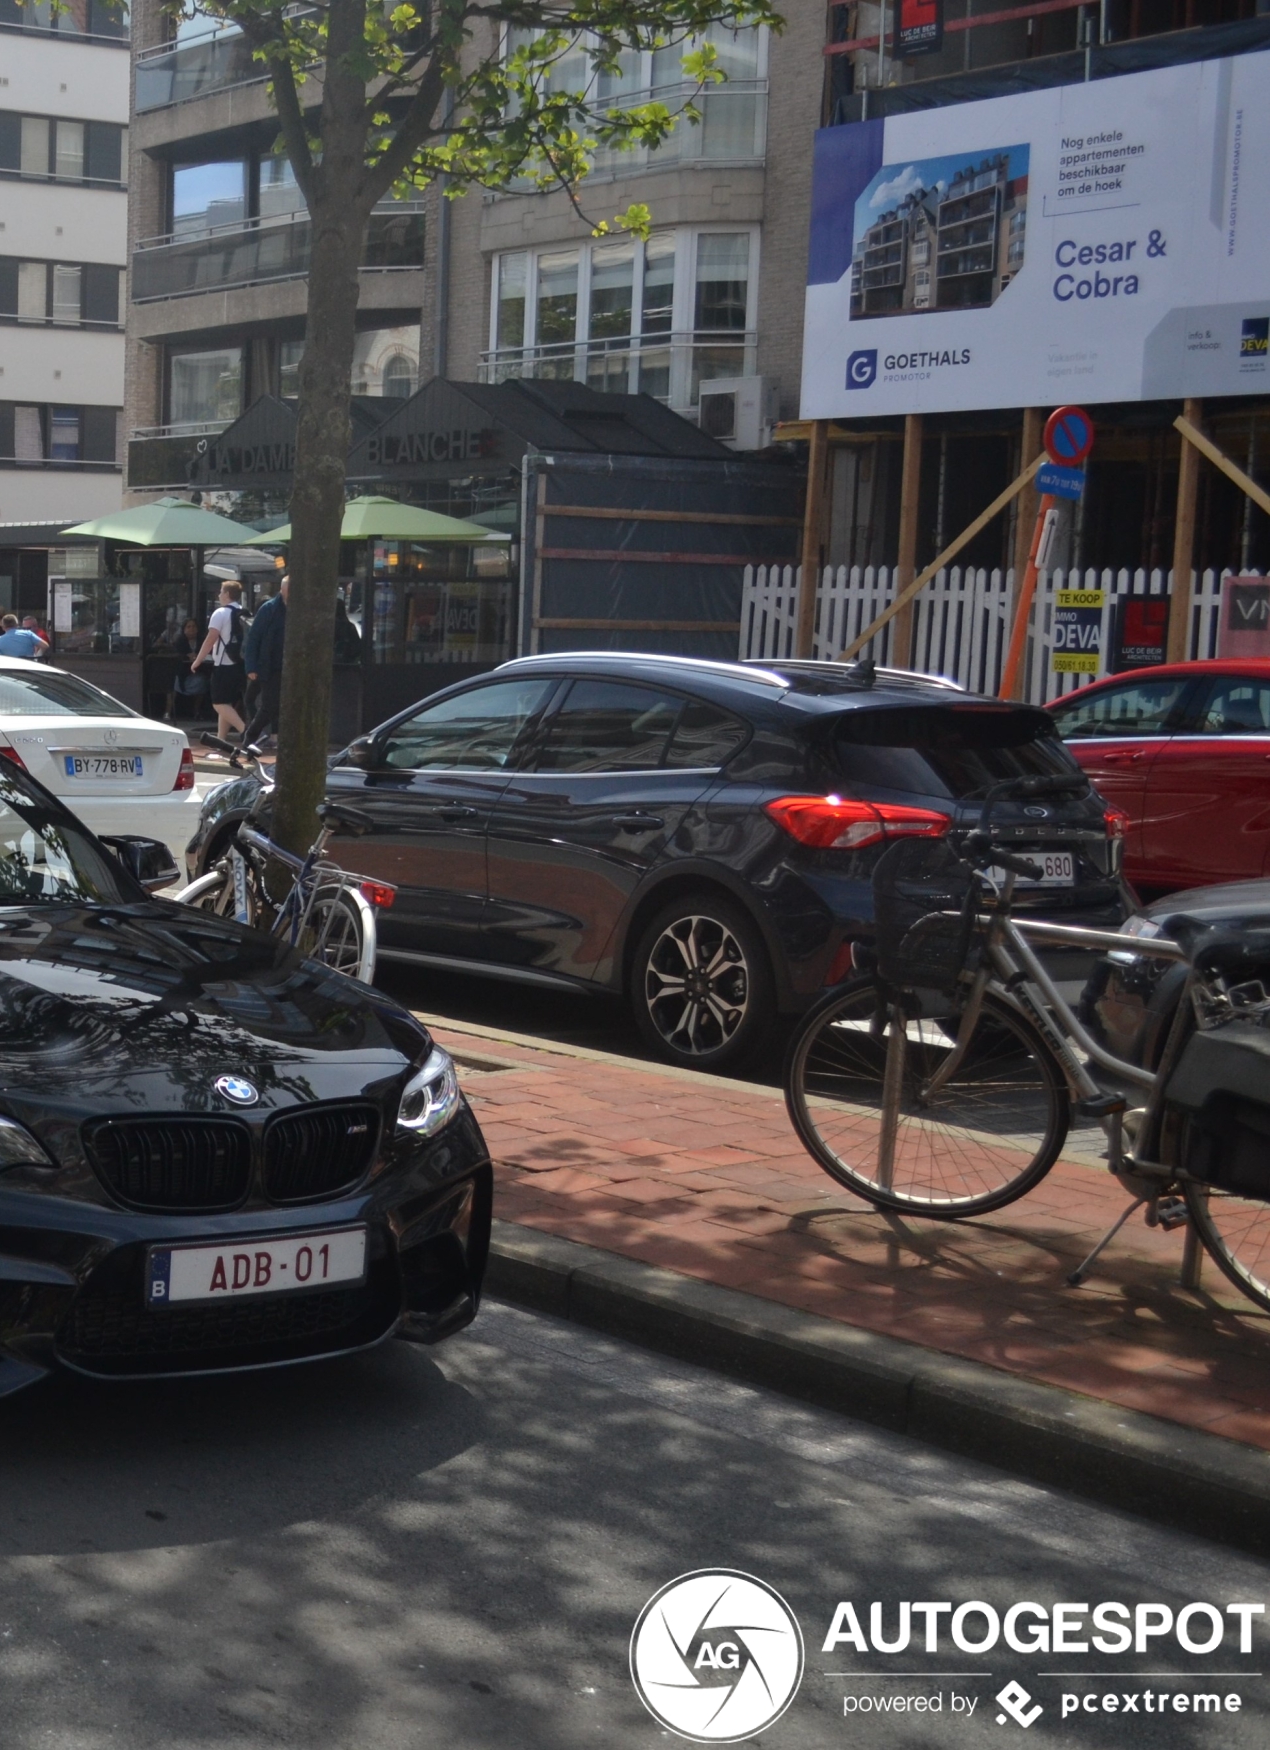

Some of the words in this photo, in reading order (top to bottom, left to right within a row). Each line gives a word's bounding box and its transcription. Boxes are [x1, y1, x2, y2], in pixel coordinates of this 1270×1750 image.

[1061, 138, 1084, 149] Nog
[1086, 131, 1123, 145] enkele
[1059, 145, 1145, 167] appartementen
[1059, 164, 1126, 181] beschikbaar
[1058, 187, 1075, 196] om
[1078, 183, 1092, 194] de
[1094, 178, 1122, 191] hoek
[1055, 240, 1136, 268] Cesar
[1146, 230, 1167, 258] &
[1053, 271, 1139, 302] Cobra
[851, 357, 872, 382] G
[884, 349, 971, 370] GOETHALS
[883, 372, 931, 382] PROMOTOR
[367, 430, 482, 464] BLANCHE
[1059, 594, 1071, 604] TE
[1073, 594, 1101, 604] KOOP
[1054, 624, 1101, 649] DEVA
[74, 759, 135, 773] BY-778-RV
[152, 1280, 166, 1297] B
[209, 1244, 330, 1292] ADB-01
